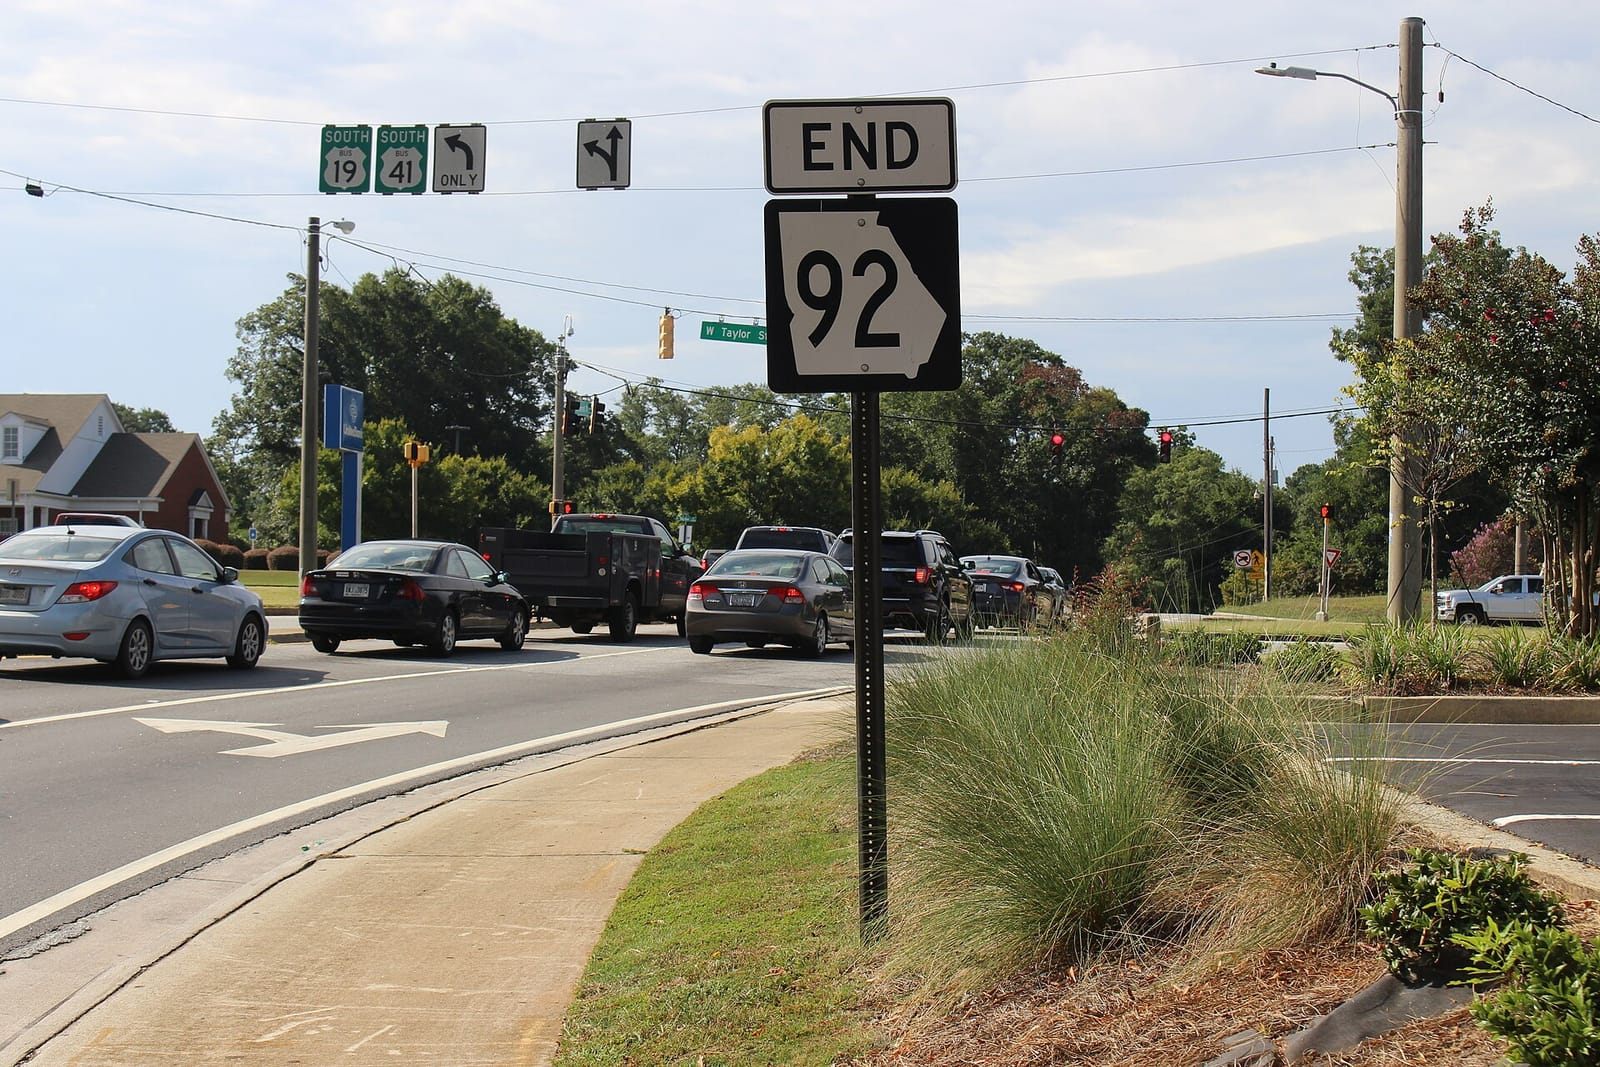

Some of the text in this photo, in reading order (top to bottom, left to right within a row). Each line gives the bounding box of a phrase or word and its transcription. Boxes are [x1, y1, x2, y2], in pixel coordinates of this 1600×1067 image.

[325, 130, 369, 143] SOUTH
[381, 130, 425, 143] SOUTH
[803, 121, 919, 171] END
[334, 160, 357, 183] 19
[389, 160, 412, 183] 41
[441, 174, 478, 186] ONLY
[797, 249, 900, 348] 92
[706, 326, 715, 336] W
[721, 327, 751, 340] Taylor
